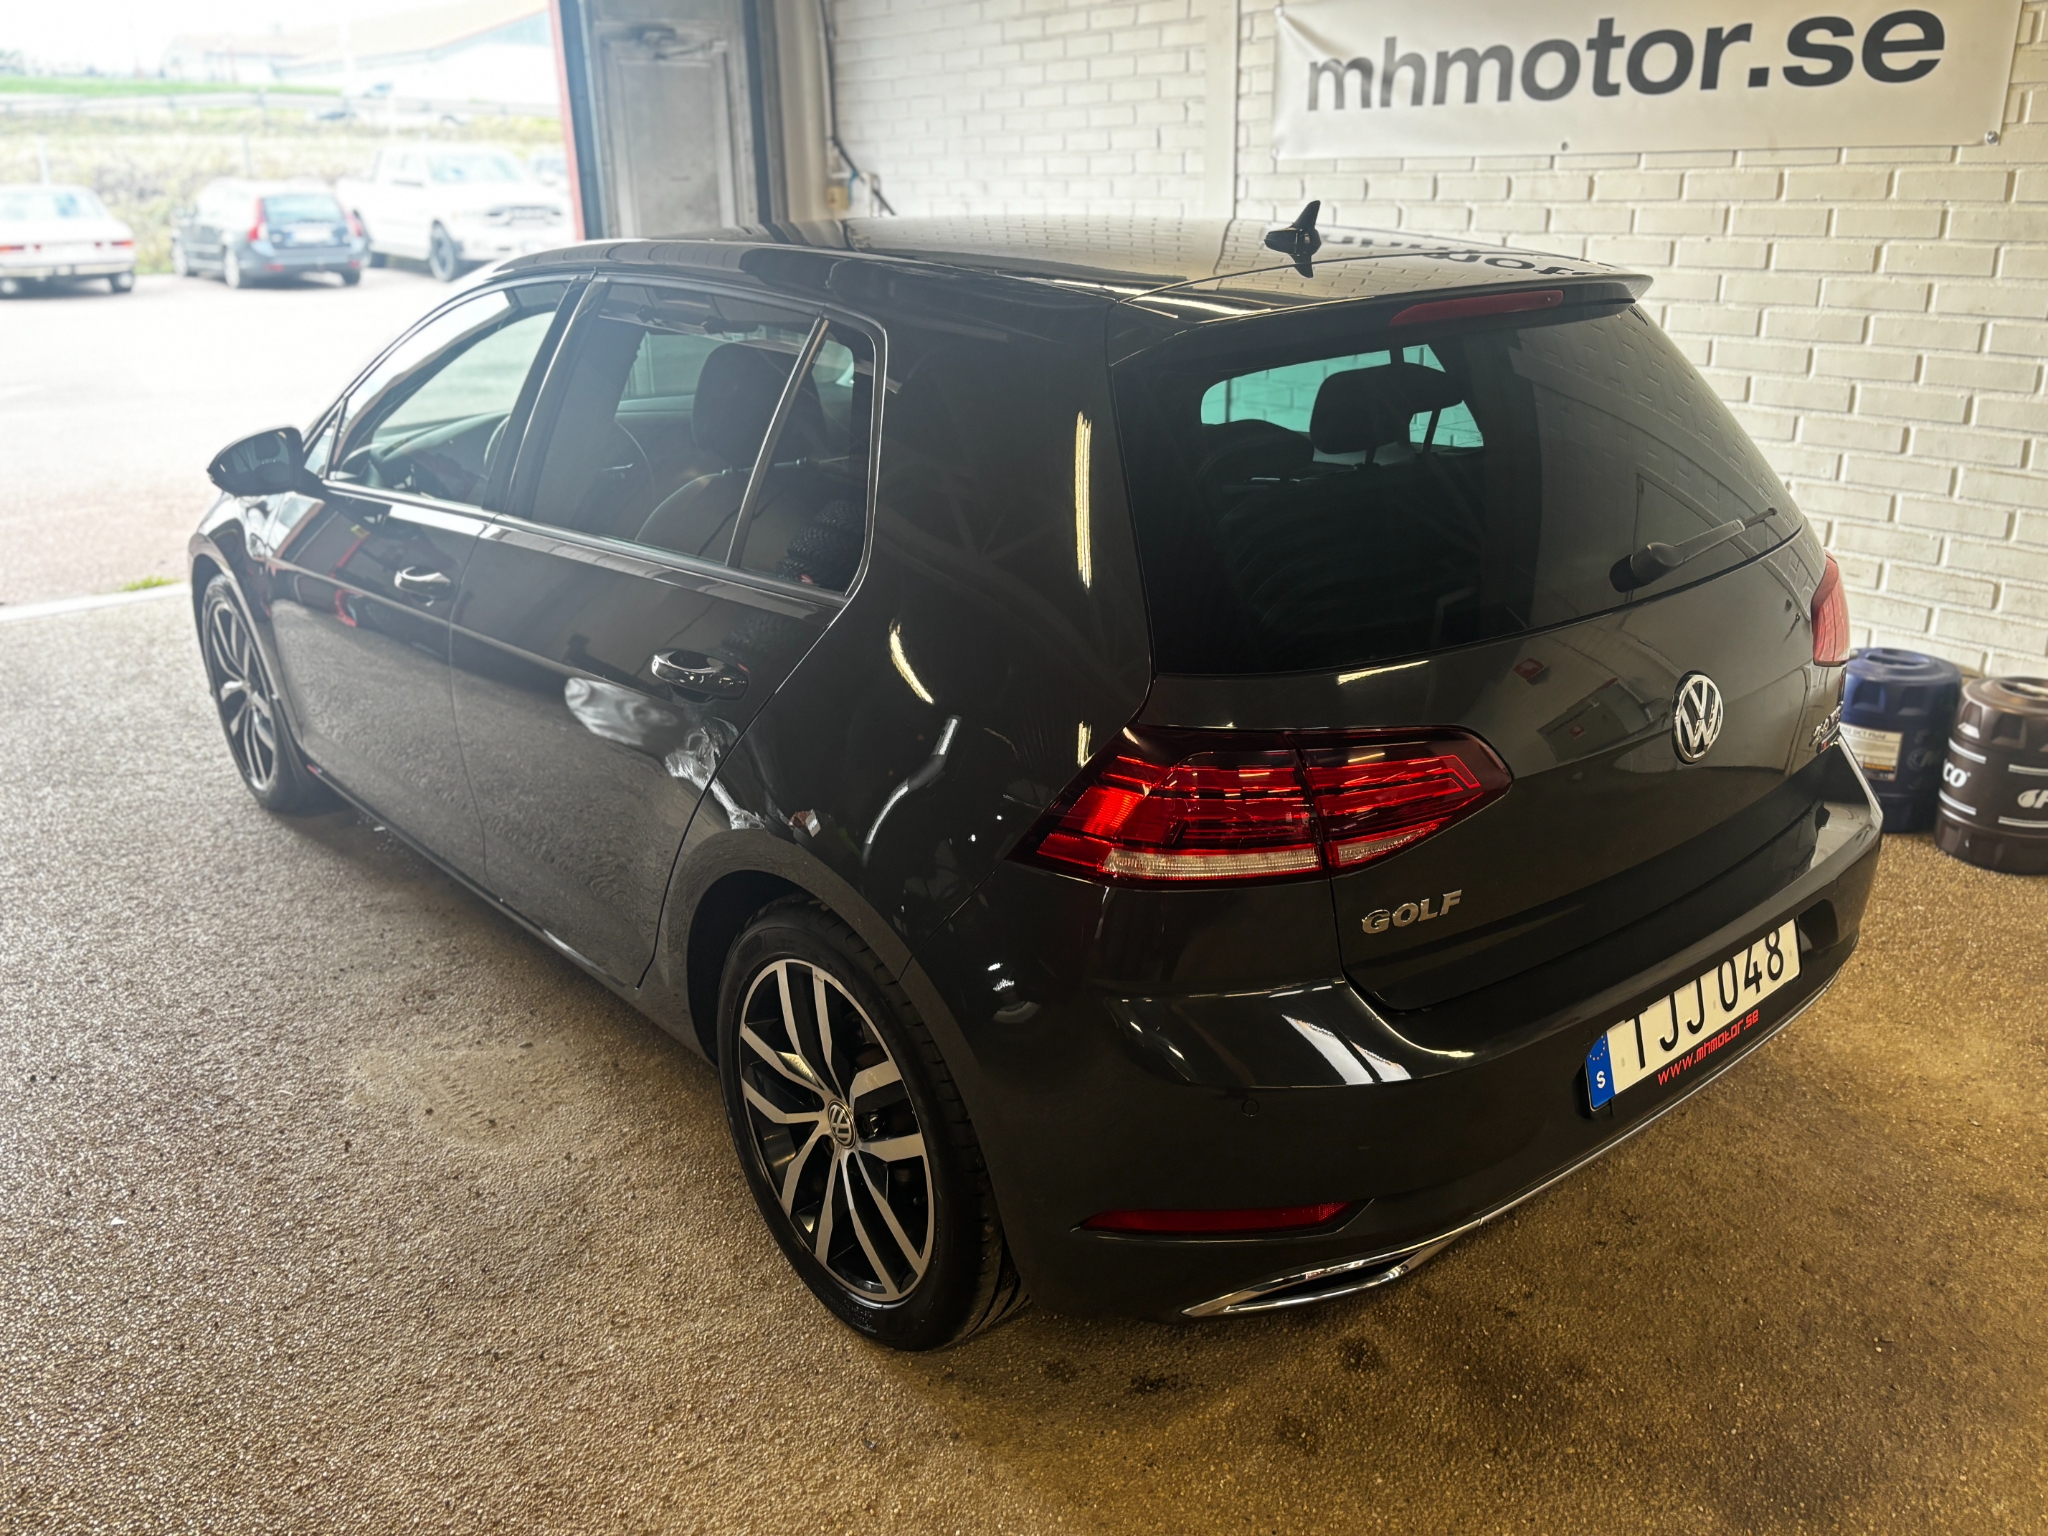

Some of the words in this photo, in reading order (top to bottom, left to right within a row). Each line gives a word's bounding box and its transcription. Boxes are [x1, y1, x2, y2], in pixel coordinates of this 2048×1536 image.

[1306, 9, 1945, 112] mhmotor.se
[1361, 889, 1462, 934] GOLF
[1596, 1070, 1606, 1089] S
[1625, 976, 1705, 1070] TJJ
[1717, 928, 1784, 1013] 048
